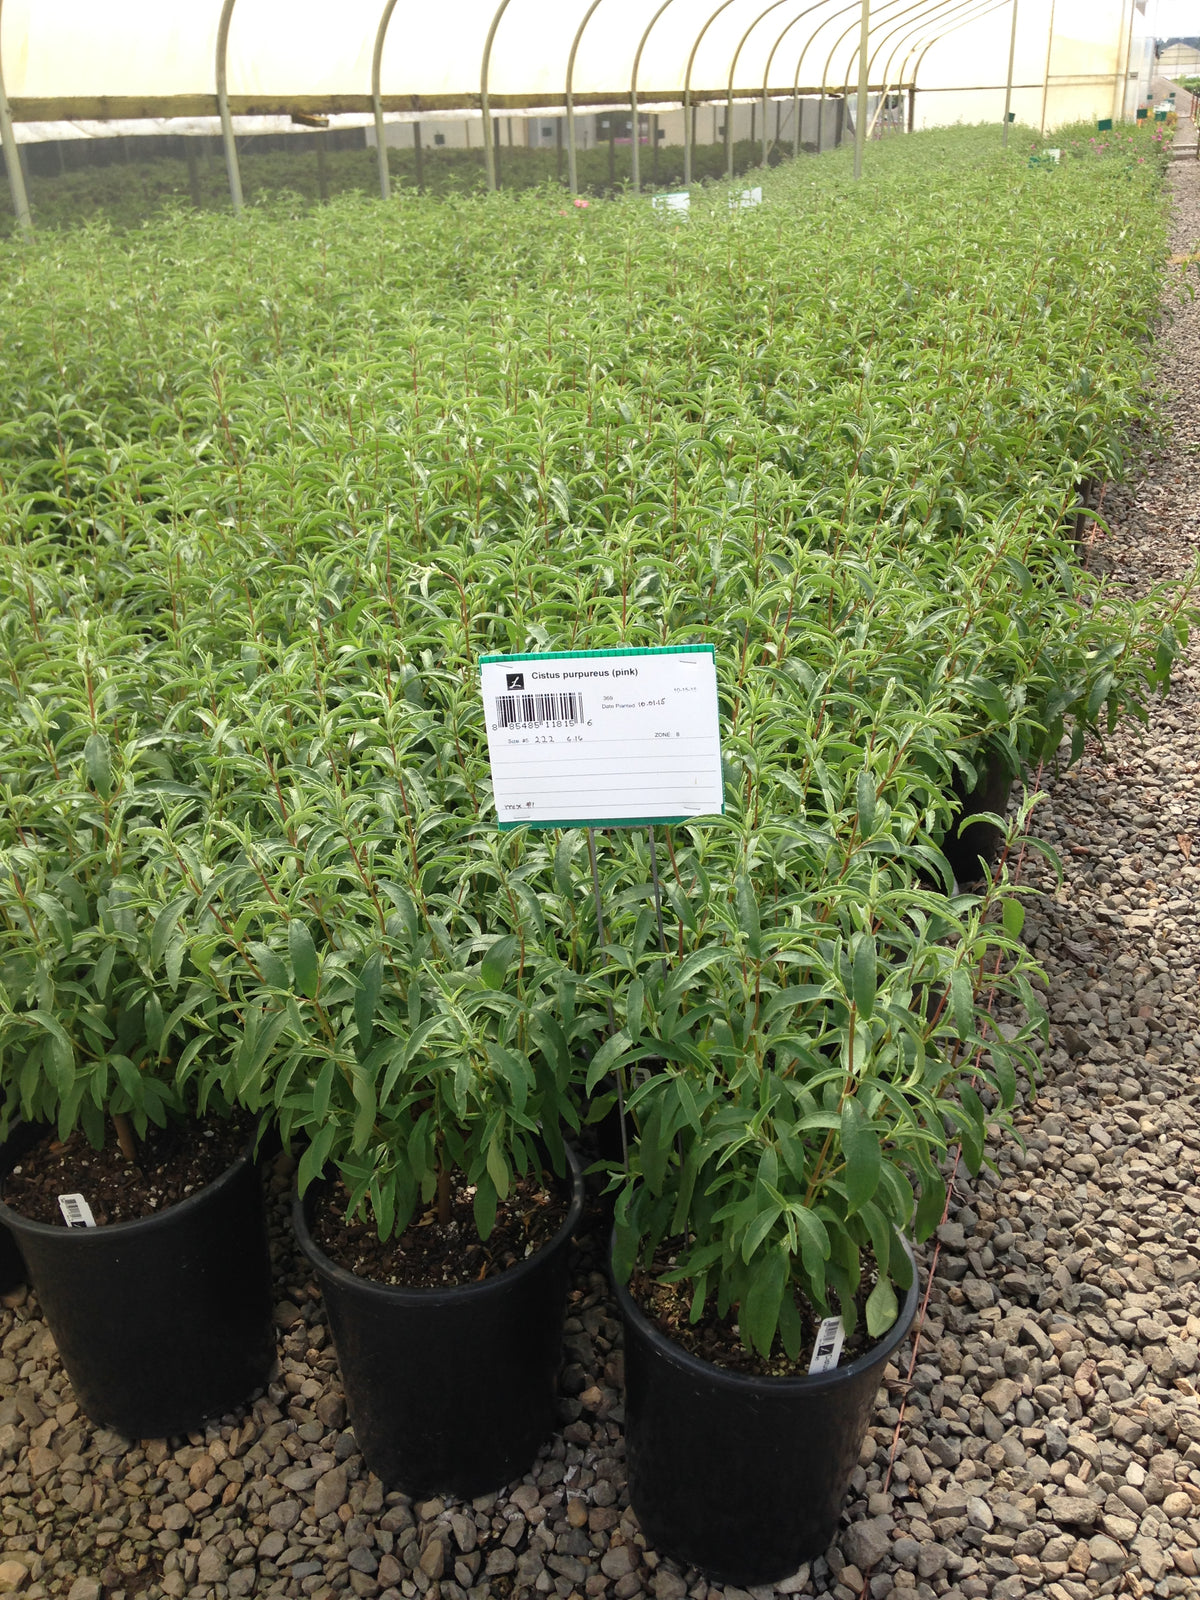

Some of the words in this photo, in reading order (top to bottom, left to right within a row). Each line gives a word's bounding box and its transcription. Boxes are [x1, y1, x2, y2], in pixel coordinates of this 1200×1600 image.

[531, 671, 561, 680] Cistus
[562, 670, 610, 680] purpureus
[611, 668, 639, 678] (pink)
[491, 723, 498, 731] 8
[508, 721, 540, 730] 85485
[546, 720, 575, 729] 11815
[586, 718, 593, 726] 6
[534, 735, 555, 744] 222
